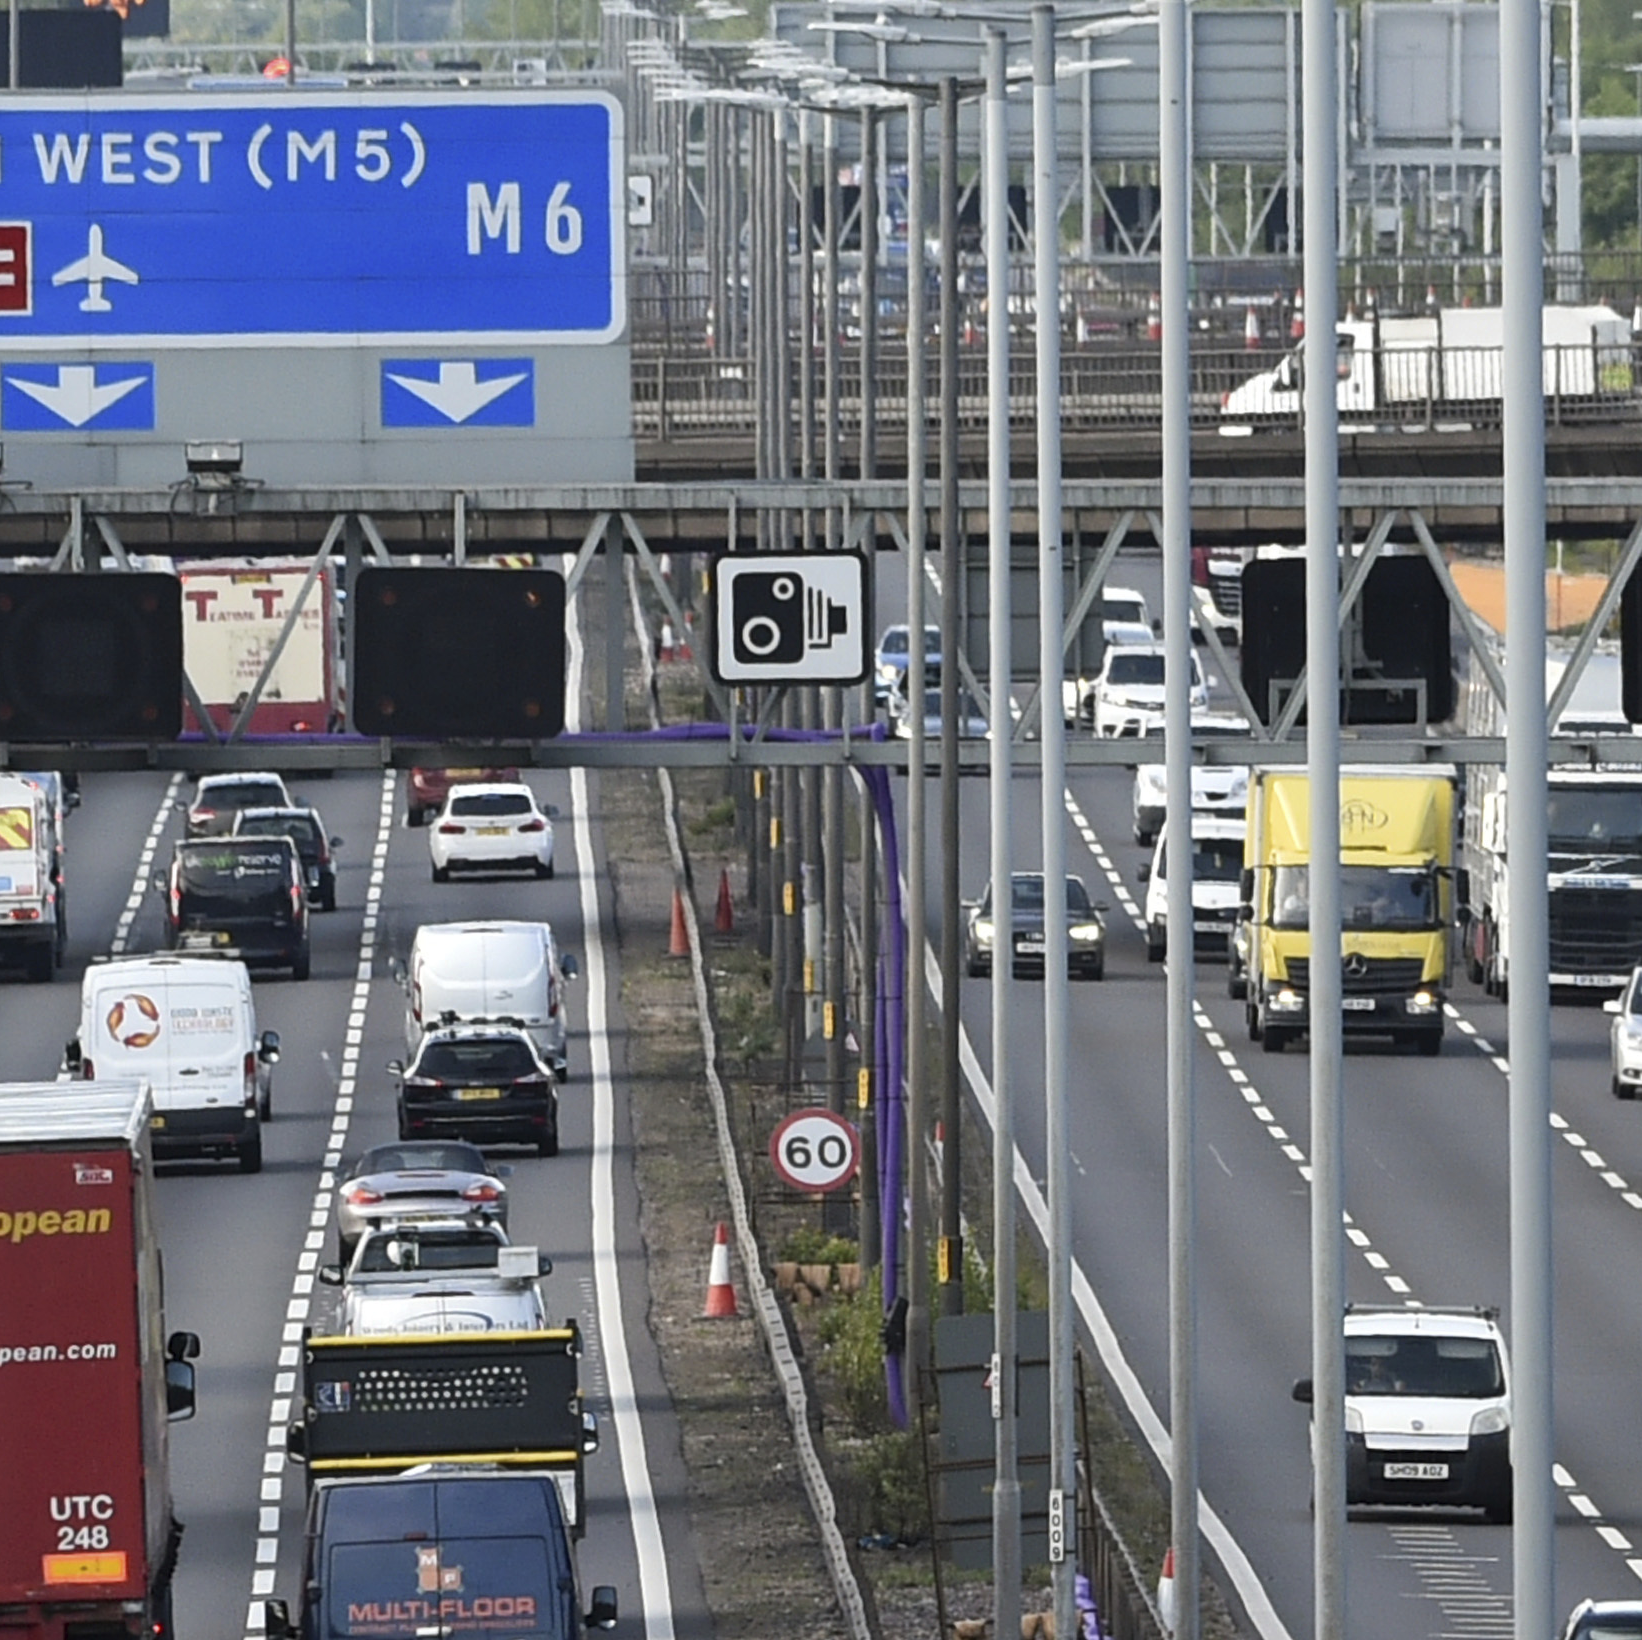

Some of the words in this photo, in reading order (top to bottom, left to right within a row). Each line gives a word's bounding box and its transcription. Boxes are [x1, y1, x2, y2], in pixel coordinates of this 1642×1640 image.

[33, 130, 222, 186] WEST
[784, 1135, 847, 1169] 60
[49, 1494, 114, 1521] UTC
[57, 1524, 109, 1551] 248
[1052, 1496, 1061, 1560] 6009
[419, 1553, 438, 1565] M
[348, 1596, 537, 1622] MULTI-FLOOR
